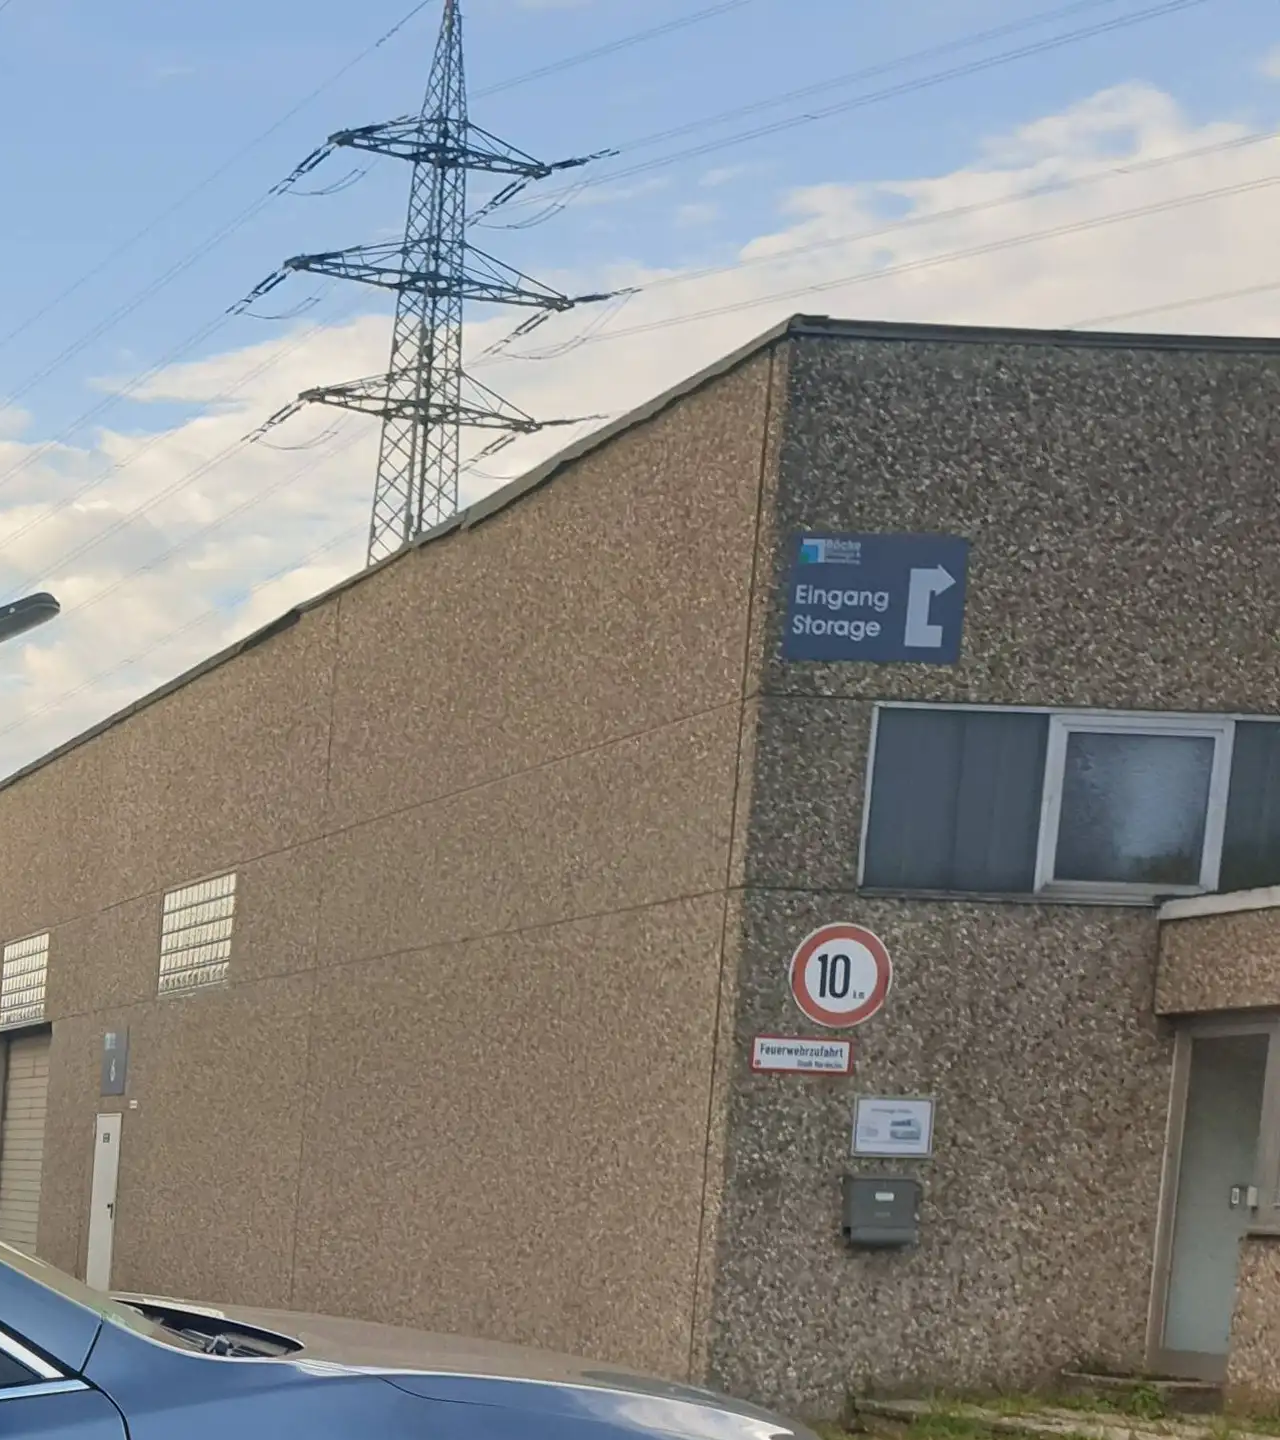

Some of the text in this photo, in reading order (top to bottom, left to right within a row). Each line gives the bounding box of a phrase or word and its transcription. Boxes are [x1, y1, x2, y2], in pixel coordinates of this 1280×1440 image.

[795, 584, 889, 612] Eingang
[792, 614, 881, 641] Storage
[817, 953, 852, 999] 10
[759, 1042, 844, 1058] Feuerwehrzufahrt
